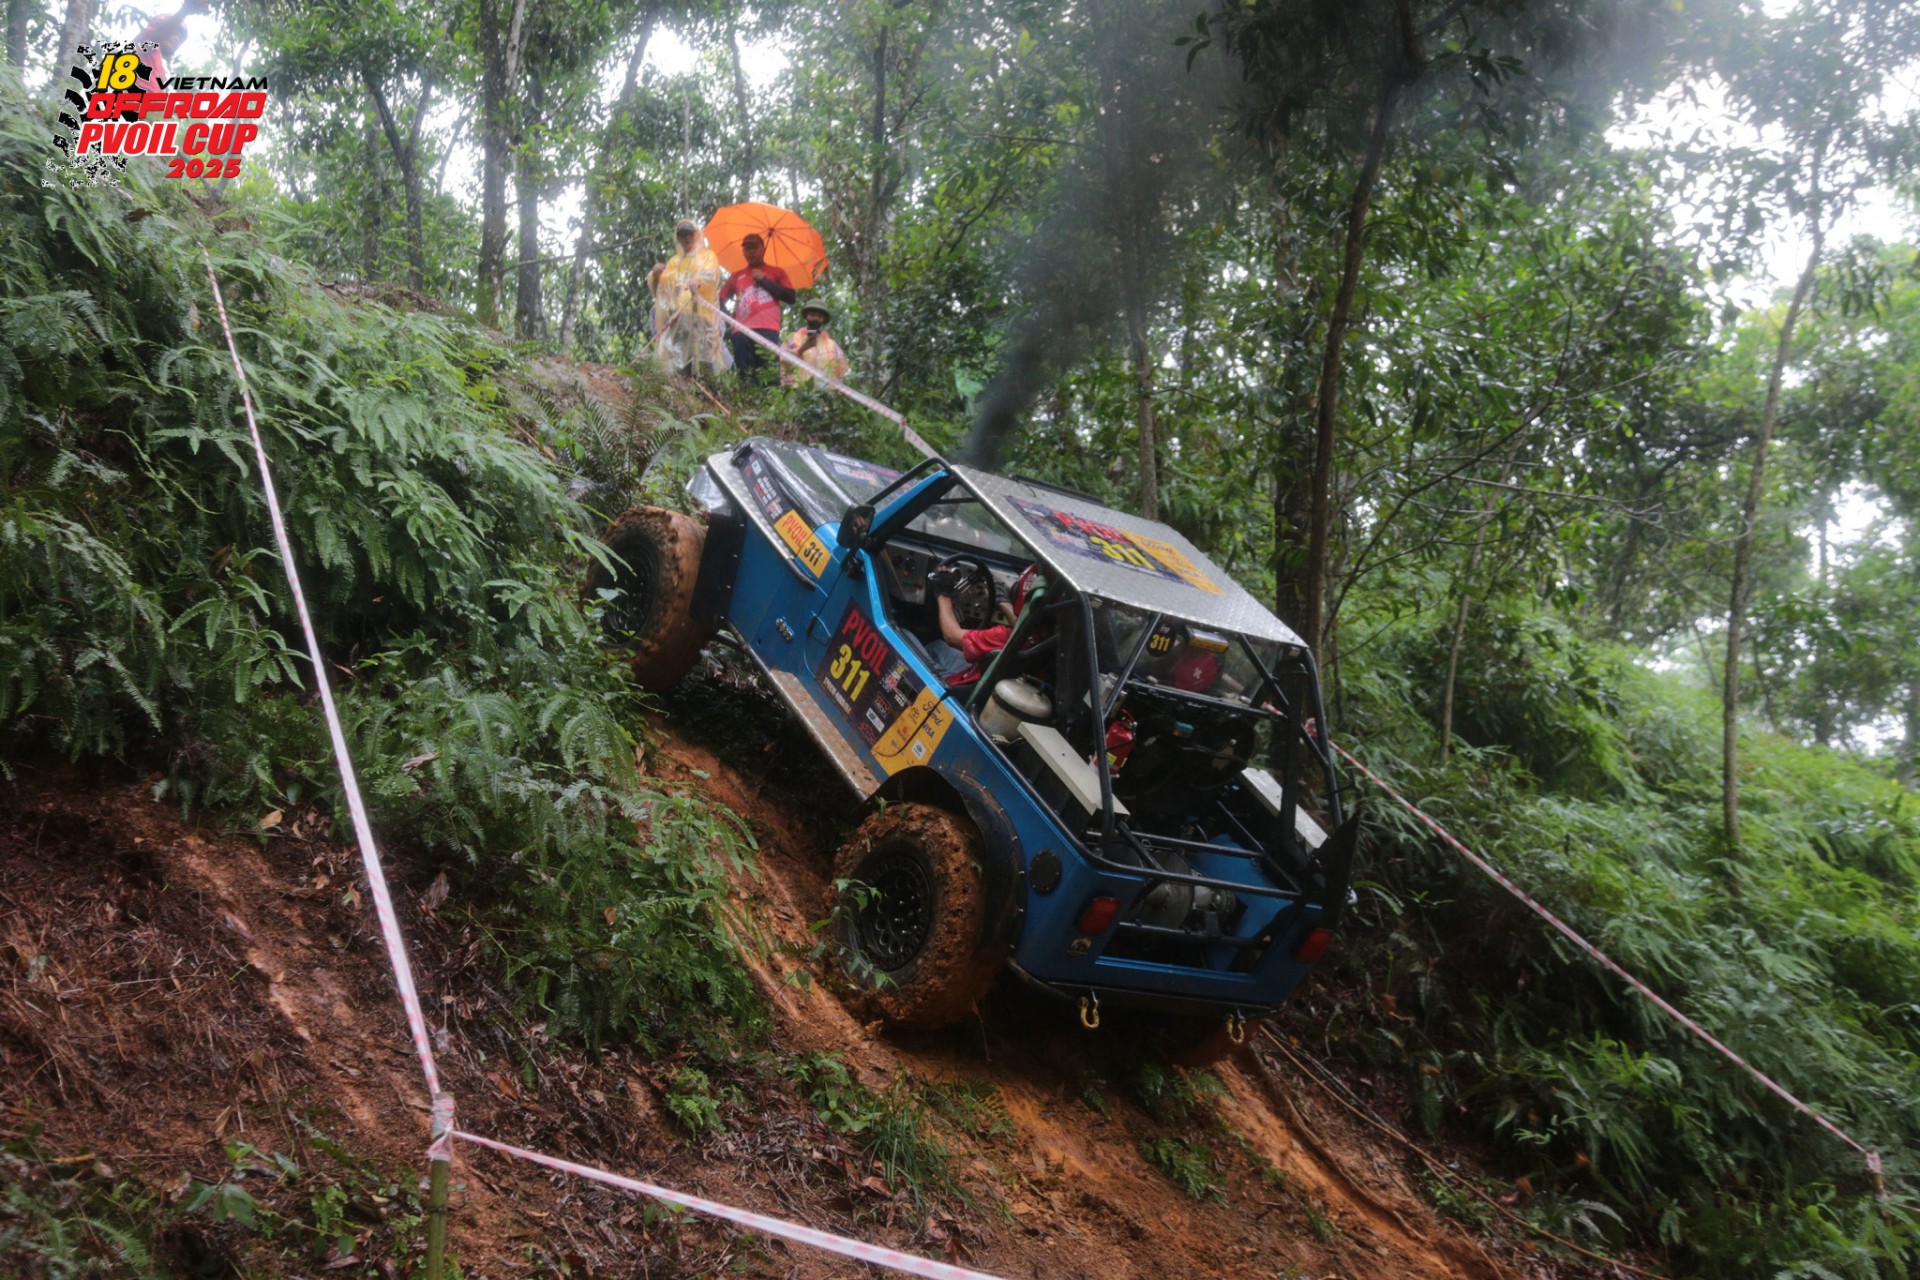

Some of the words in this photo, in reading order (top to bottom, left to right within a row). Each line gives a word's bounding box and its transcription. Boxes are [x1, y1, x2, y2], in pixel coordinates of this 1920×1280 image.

[782, 514, 807, 548] PVOIL
[803, 541, 823, 567] 311
[1089, 535, 1156, 571] 311
[841, 609, 889, 677] PVOIL
[1149, 633, 1171, 652] 311
[830, 643, 870, 702] 311
